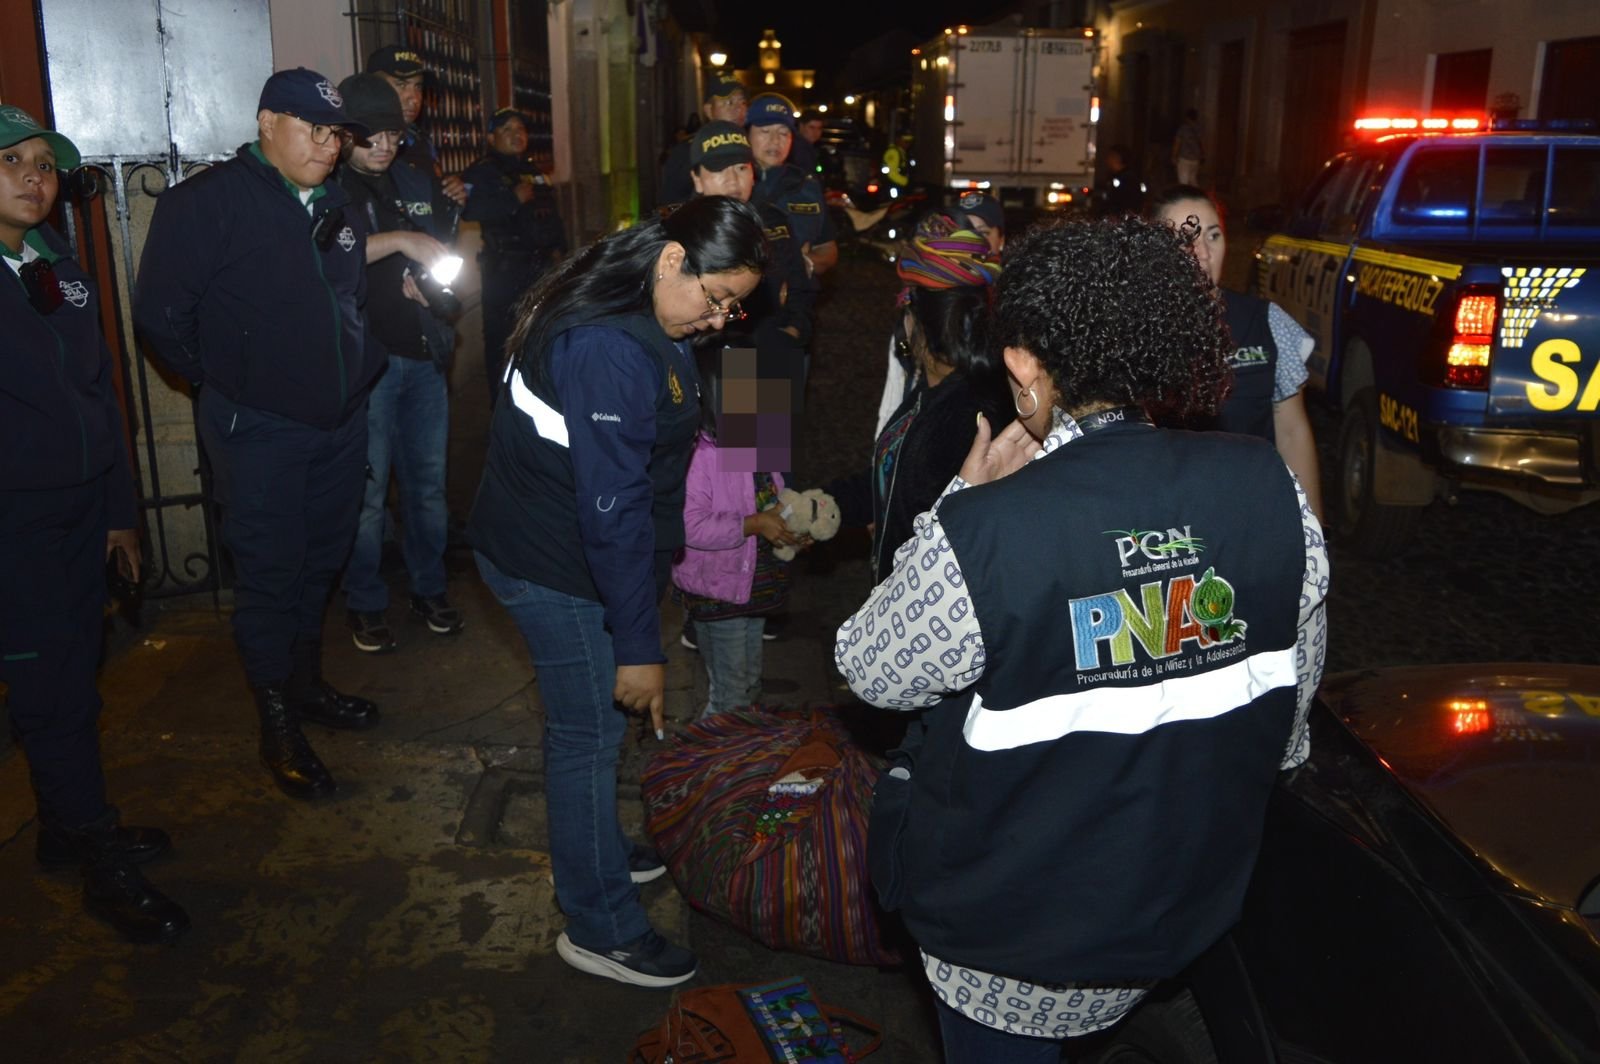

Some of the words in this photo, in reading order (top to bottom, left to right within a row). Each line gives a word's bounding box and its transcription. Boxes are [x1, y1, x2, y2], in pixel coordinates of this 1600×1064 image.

[1098, 410, 1125, 425] PGN
[1115, 525, 1198, 567] PGN
[1077, 665, 1139, 685] Procuraduría
[1141, 665, 1153, 678] de
[1155, 663, 1164, 675] la
[1165, 657, 1187, 672] Niñez
[1188, 658, 1193, 669] y
[1195, 654, 1203, 666] la
